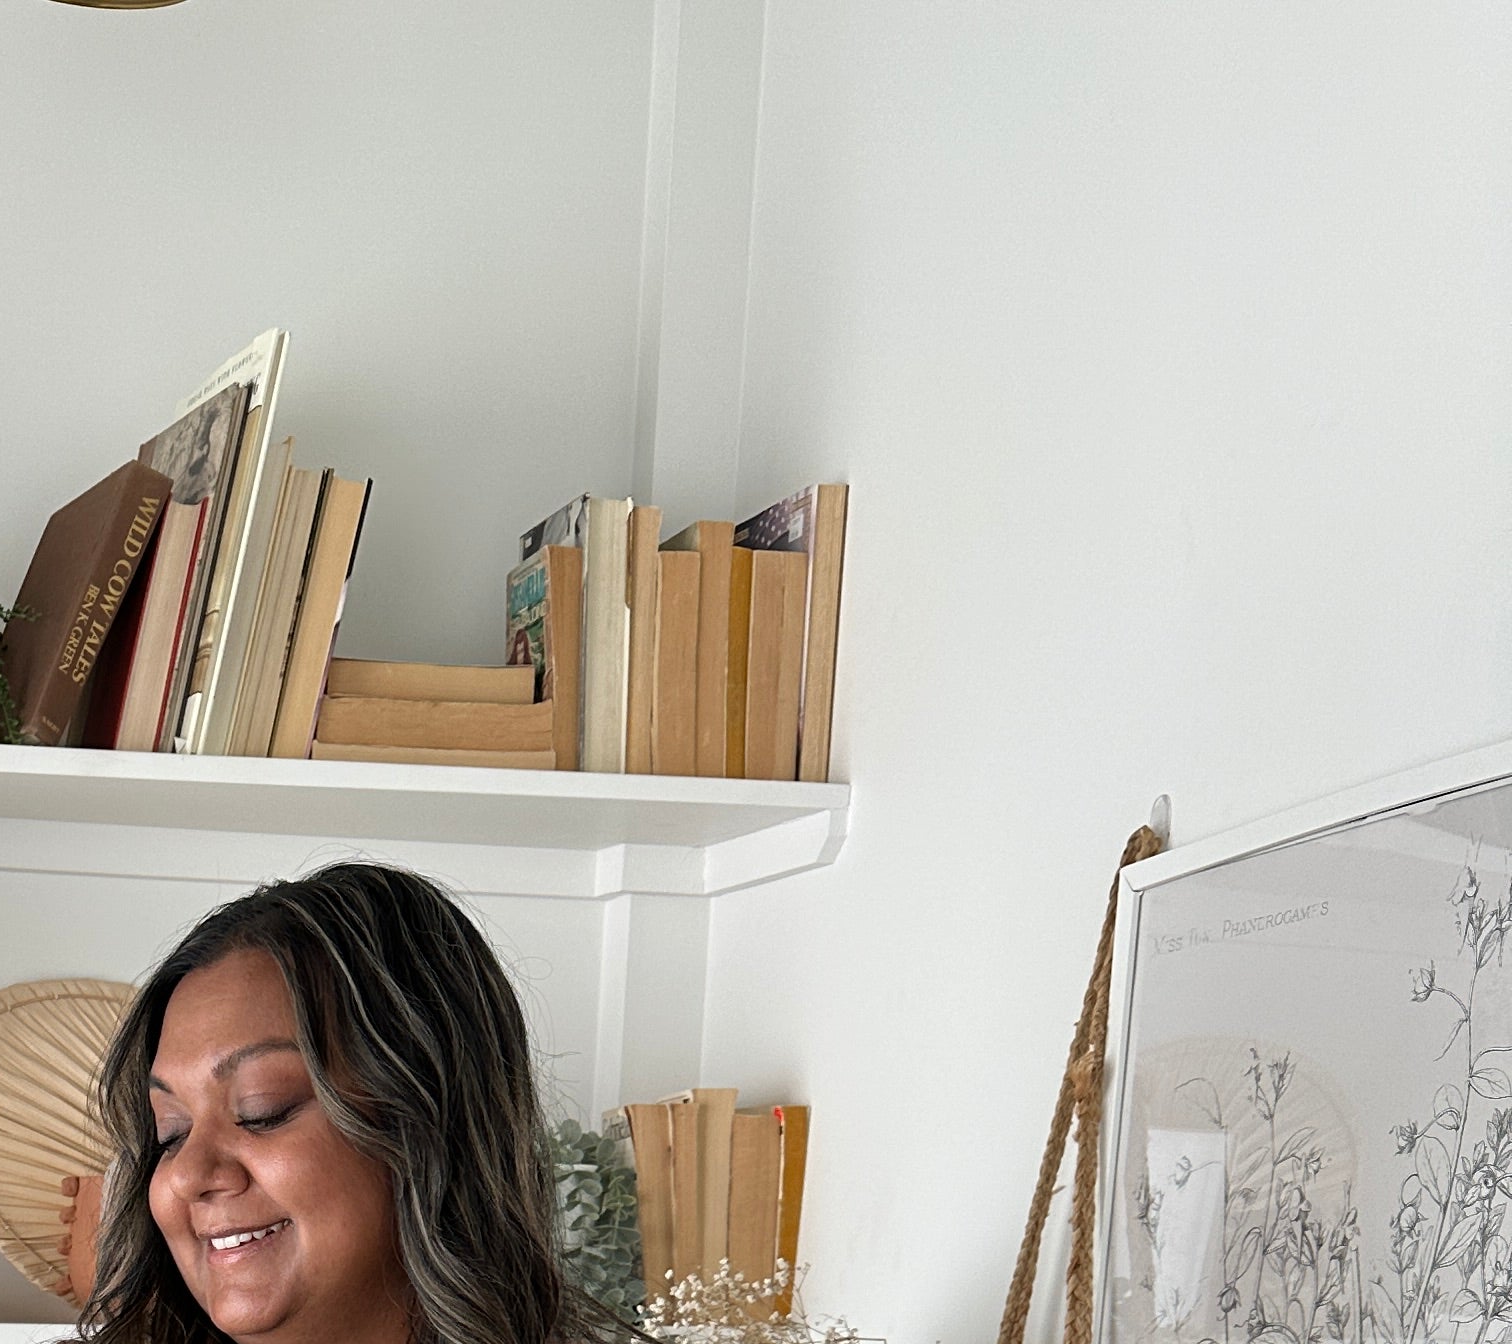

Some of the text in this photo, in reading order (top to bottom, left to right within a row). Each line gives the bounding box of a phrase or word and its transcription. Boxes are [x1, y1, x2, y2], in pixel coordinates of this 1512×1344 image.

[58, 583, 101, 675] BEN K GREEN
[72, 496, 160, 687] WILD COW TALES
